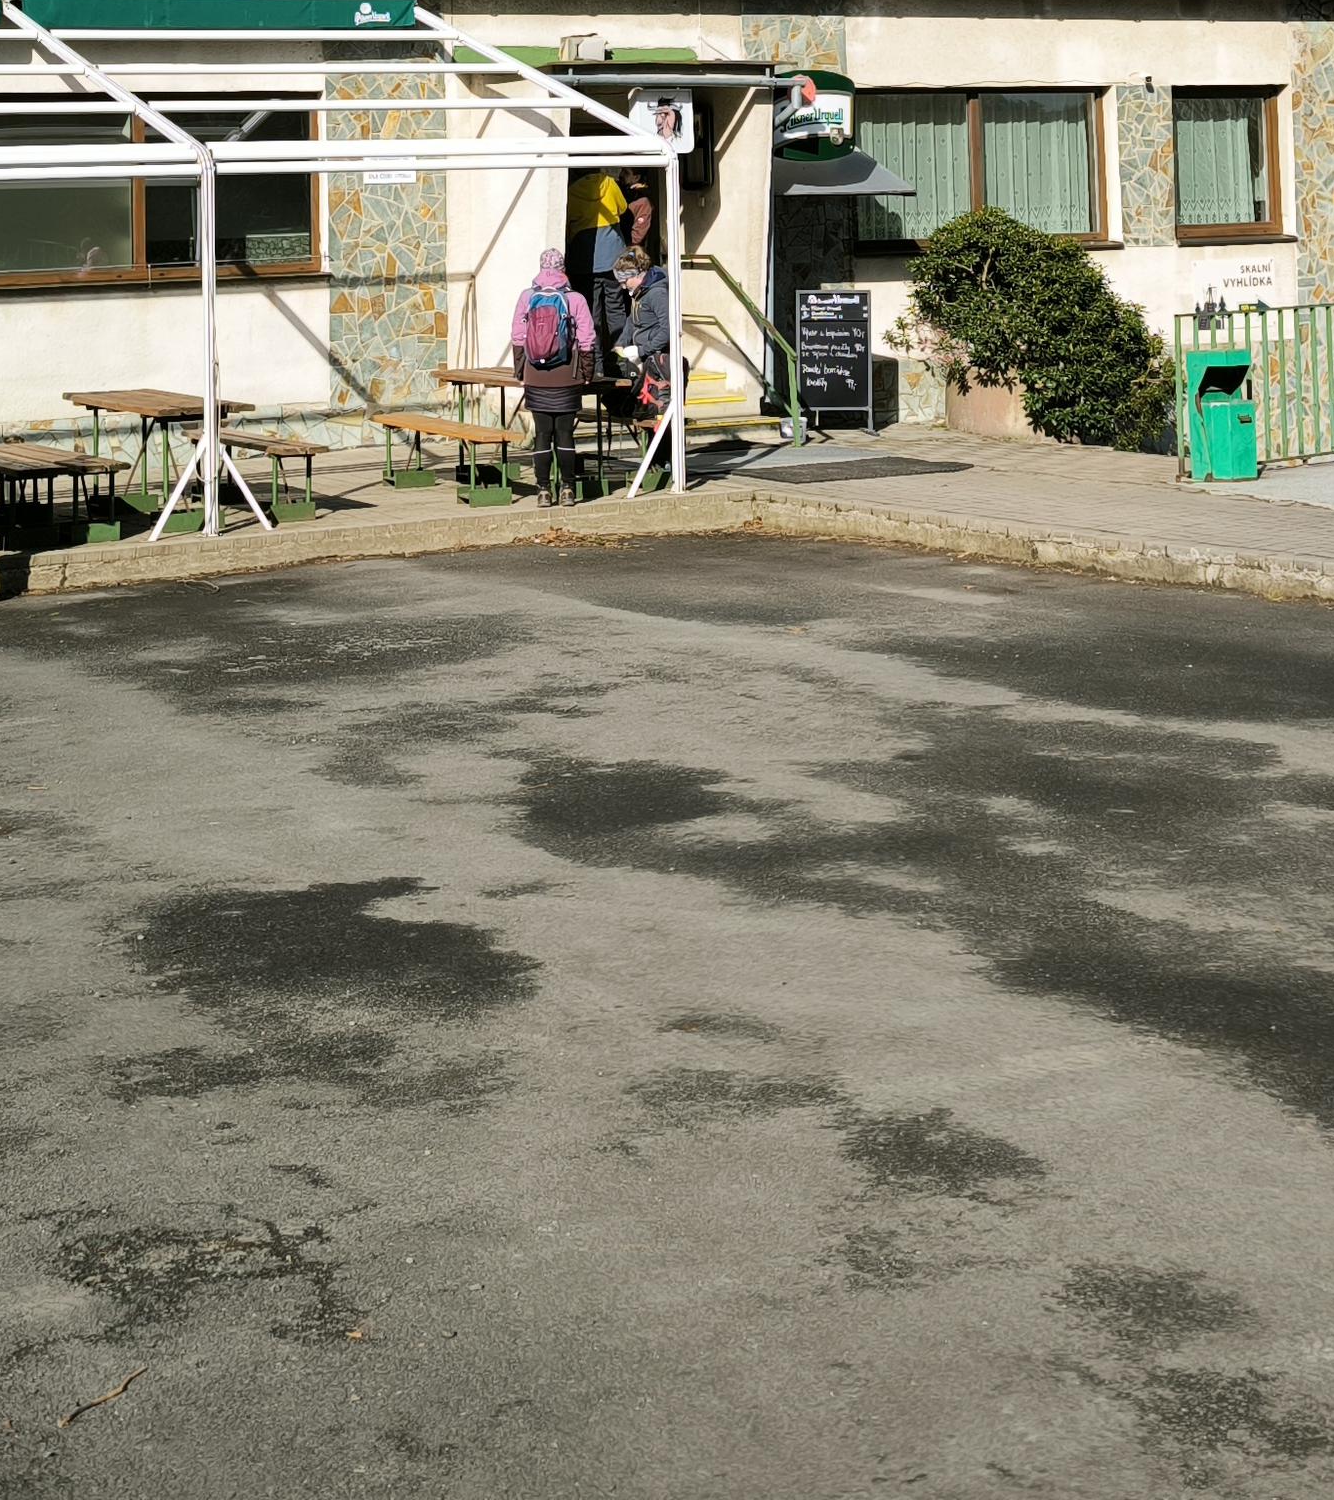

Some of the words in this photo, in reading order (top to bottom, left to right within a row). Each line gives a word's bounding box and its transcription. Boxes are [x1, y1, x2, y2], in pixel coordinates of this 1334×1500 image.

[813, 107, 844, 125] Urquell
[1240, 263, 1271, 274] SKALNÍ
[1223, 275, 1273, 288] VYHLÍDKA
